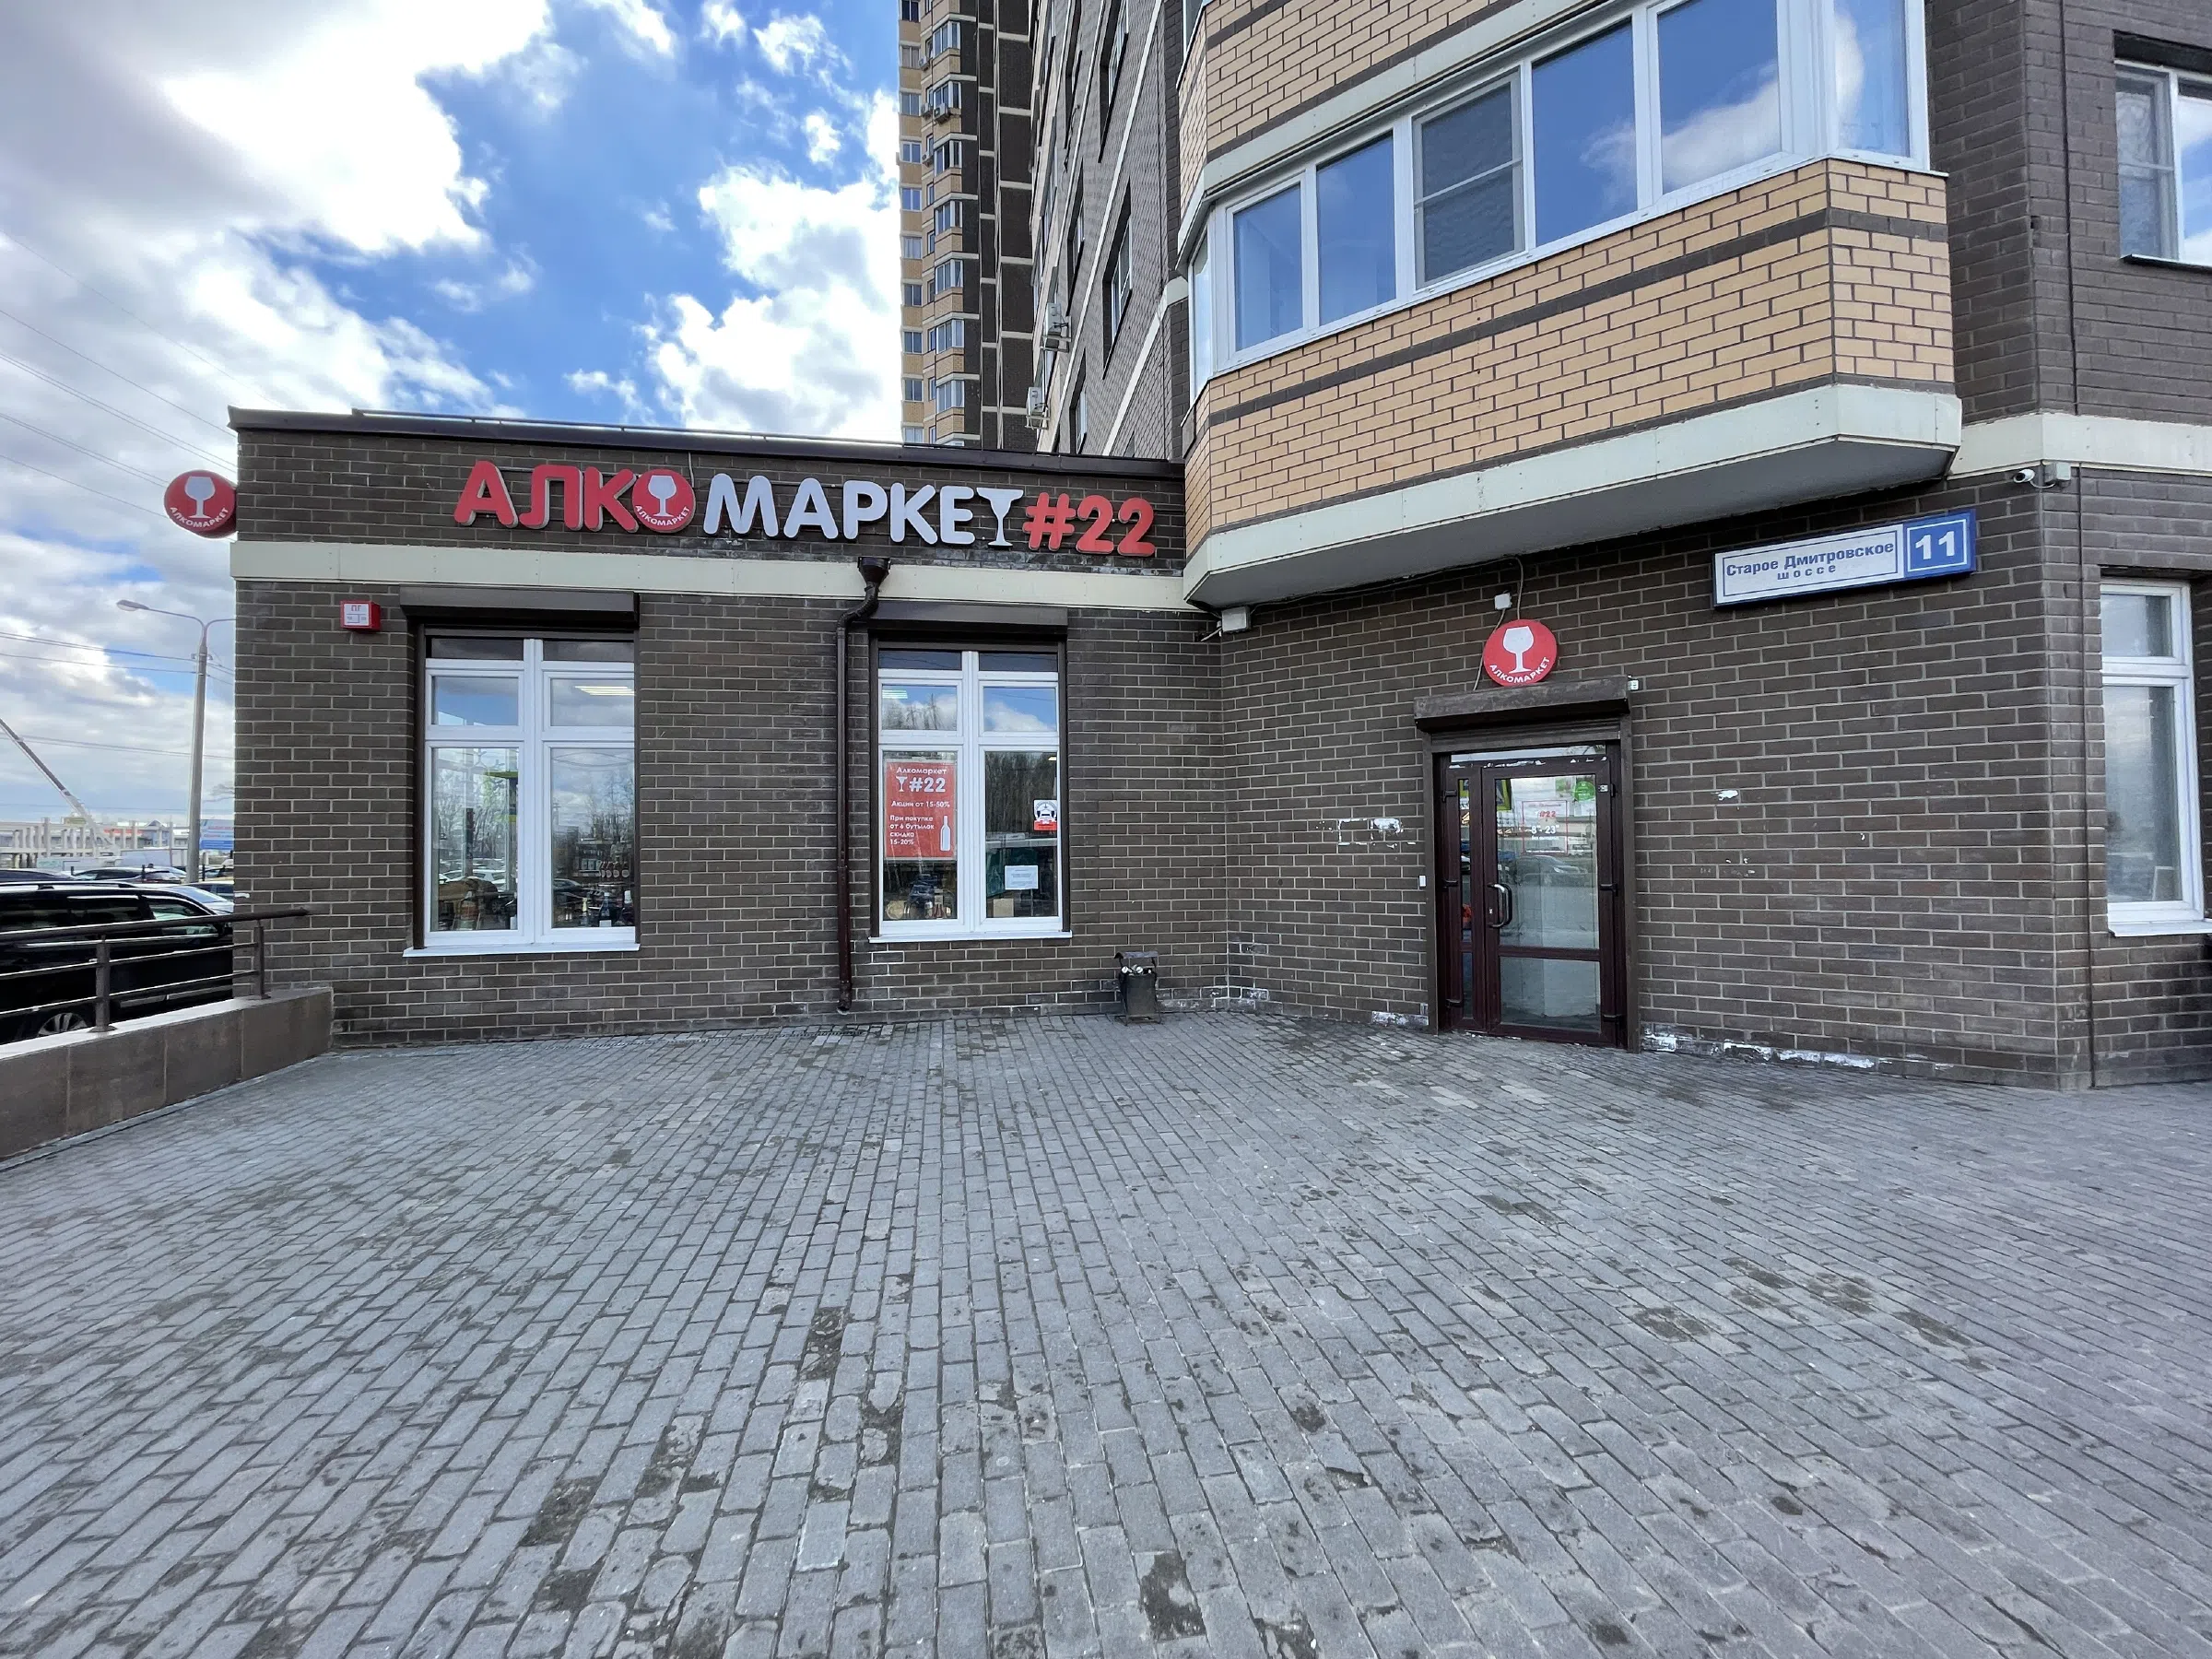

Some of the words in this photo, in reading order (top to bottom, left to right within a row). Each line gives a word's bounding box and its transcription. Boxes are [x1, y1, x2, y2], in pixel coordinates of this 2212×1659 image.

[170, 507, 229, 528] АЛКОМАРКЕТ
[635, 505, 690, 526] АЛКОМАРКЕТ
[1021, 492, 1157, 557] #22
[1914, 530, 1956, 560] 11
[1726, 559, 1779, 577] Старое
[1783, 542, 1895, 571] Дмитровское
[1777, 563, 1837, 582] шоссе
[1489, 656, 1550, 684] АЛКОМАРКЕТ
[896, 766, 947, 775] Алкомаркет
[909, 776, 946, 793] #22
[889, 814, 904, 822] При
[905, 815, 934, 823] покупке
